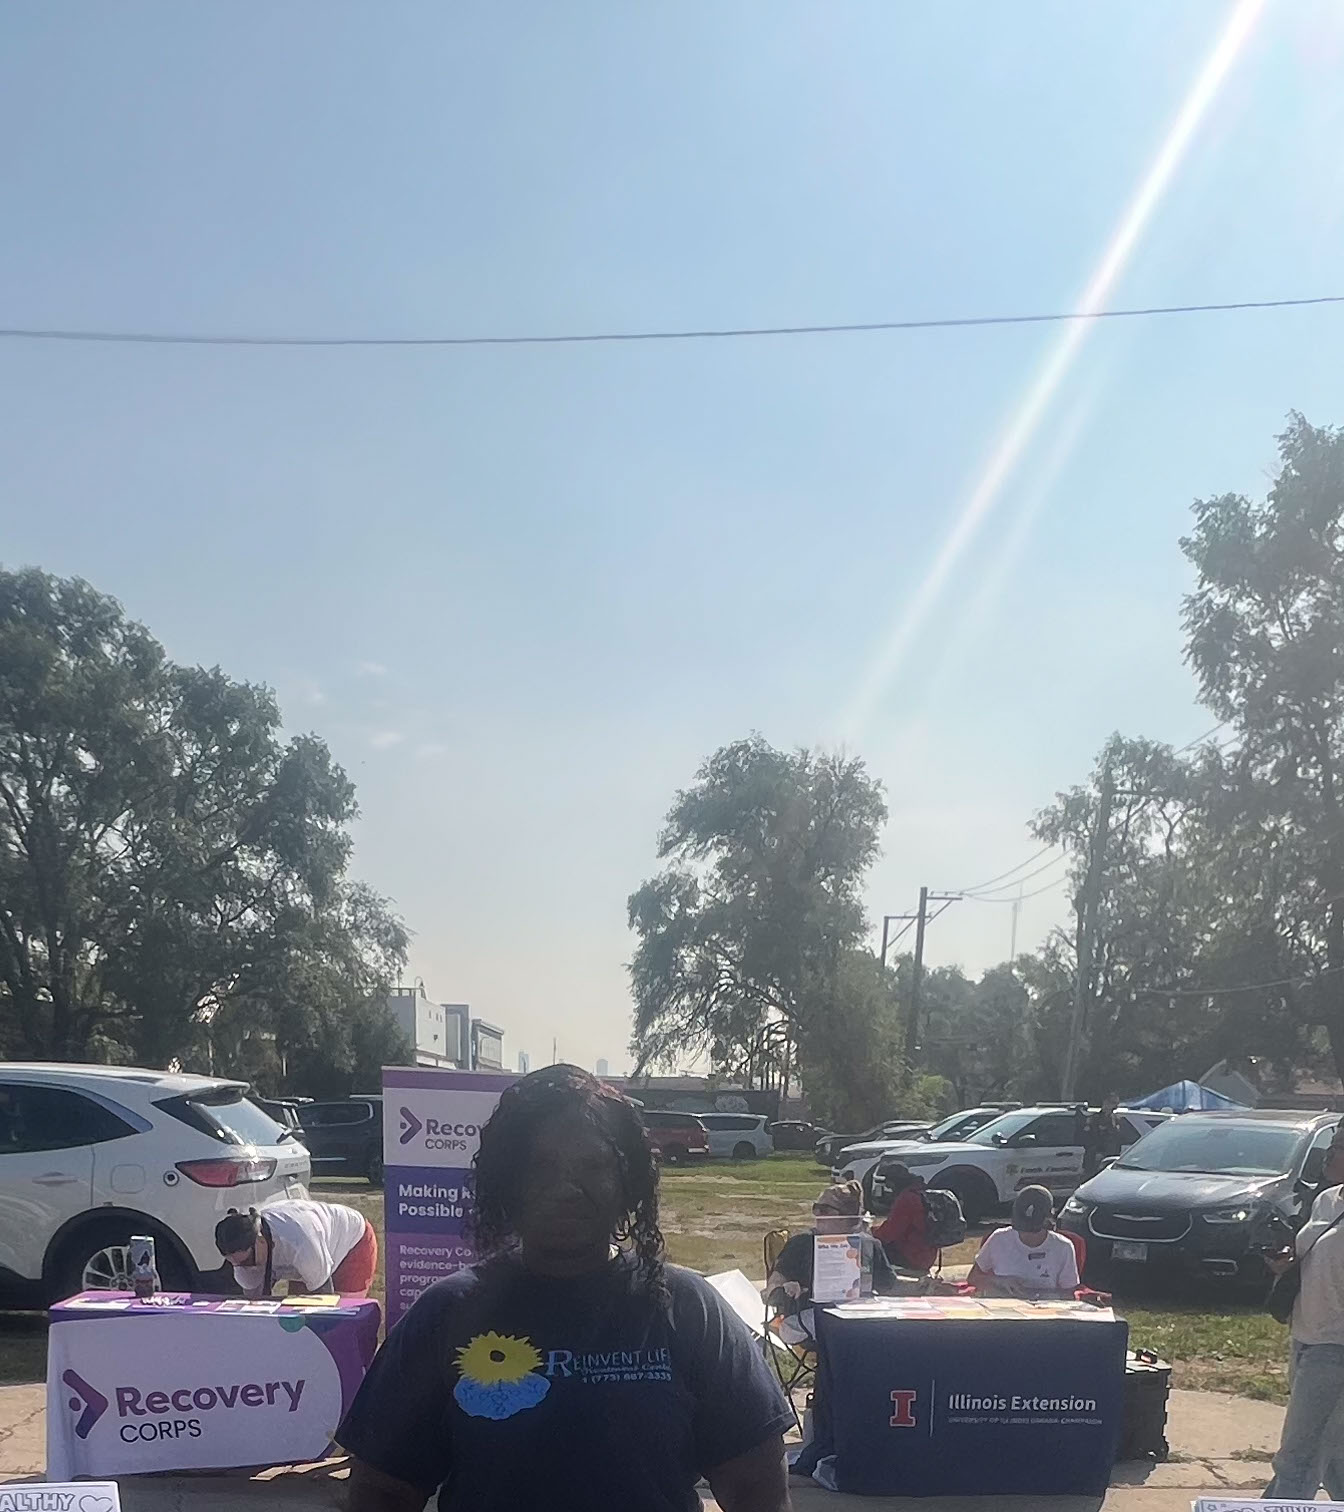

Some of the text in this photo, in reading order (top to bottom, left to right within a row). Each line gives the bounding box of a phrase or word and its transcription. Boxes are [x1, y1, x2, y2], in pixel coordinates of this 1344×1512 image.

[425, 1138, 467, 1151] CORPS
[398, 1184, 458, 1202] Making
[398, 1203, 464, 1218] Possible
[399, 1245, 453, 1258] Recovery
[115, 1380, 305, 1417] Recovery
[948, 1394, 1007, 1410] Illinois
[1010, 1395, 1097, 1411] Extension
[119, 1419, 202, 1443] CORPS
